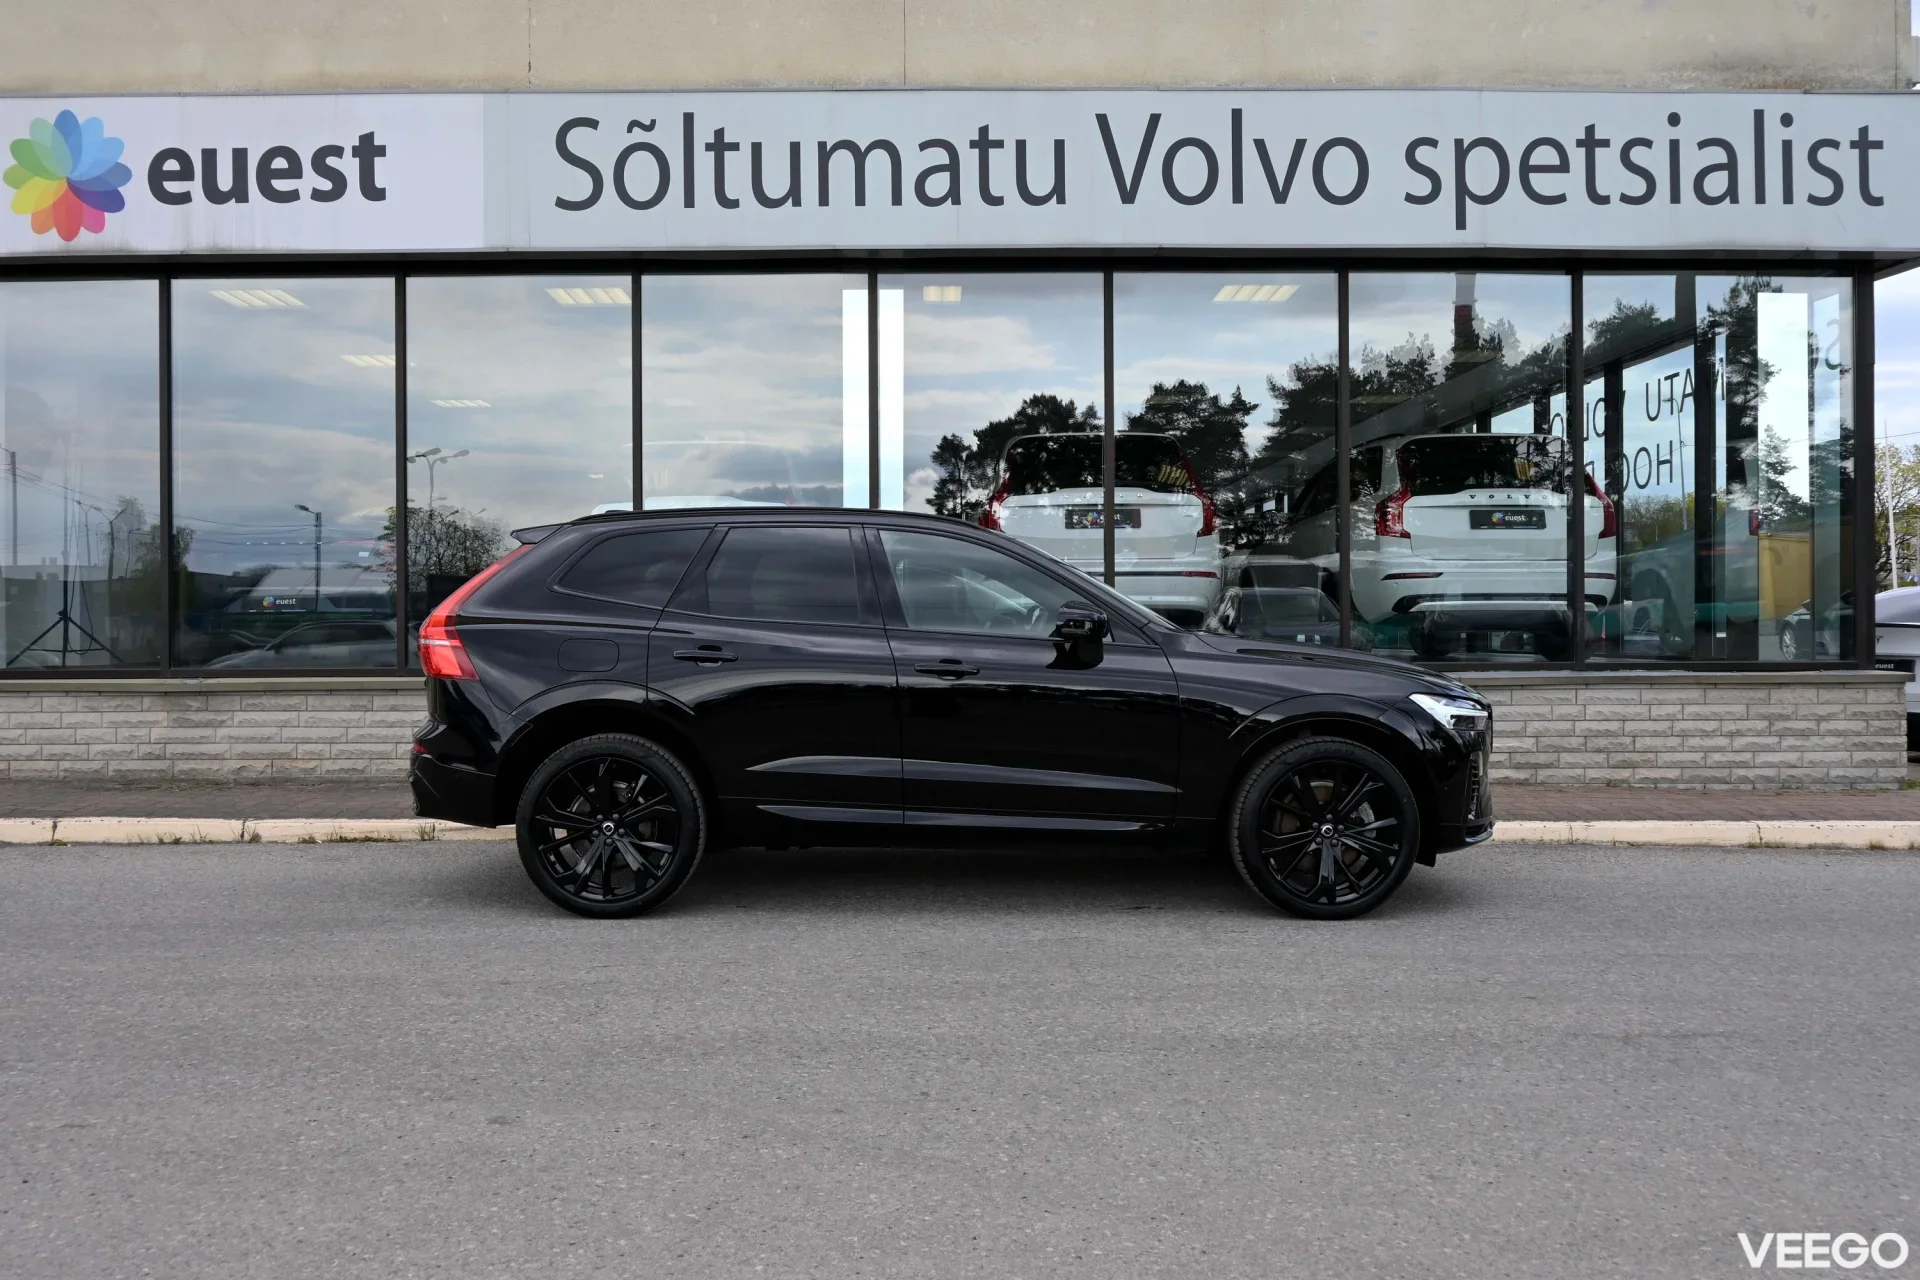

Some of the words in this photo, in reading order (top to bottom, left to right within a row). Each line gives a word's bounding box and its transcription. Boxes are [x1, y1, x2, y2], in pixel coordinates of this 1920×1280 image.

[147, 131, 387, 206] euest
[554, 111, 1066, 211] Sõltumatu
[1094, 108, 1370, 206] Volvo
[1404, 108, 1885, 230] spetsialist
